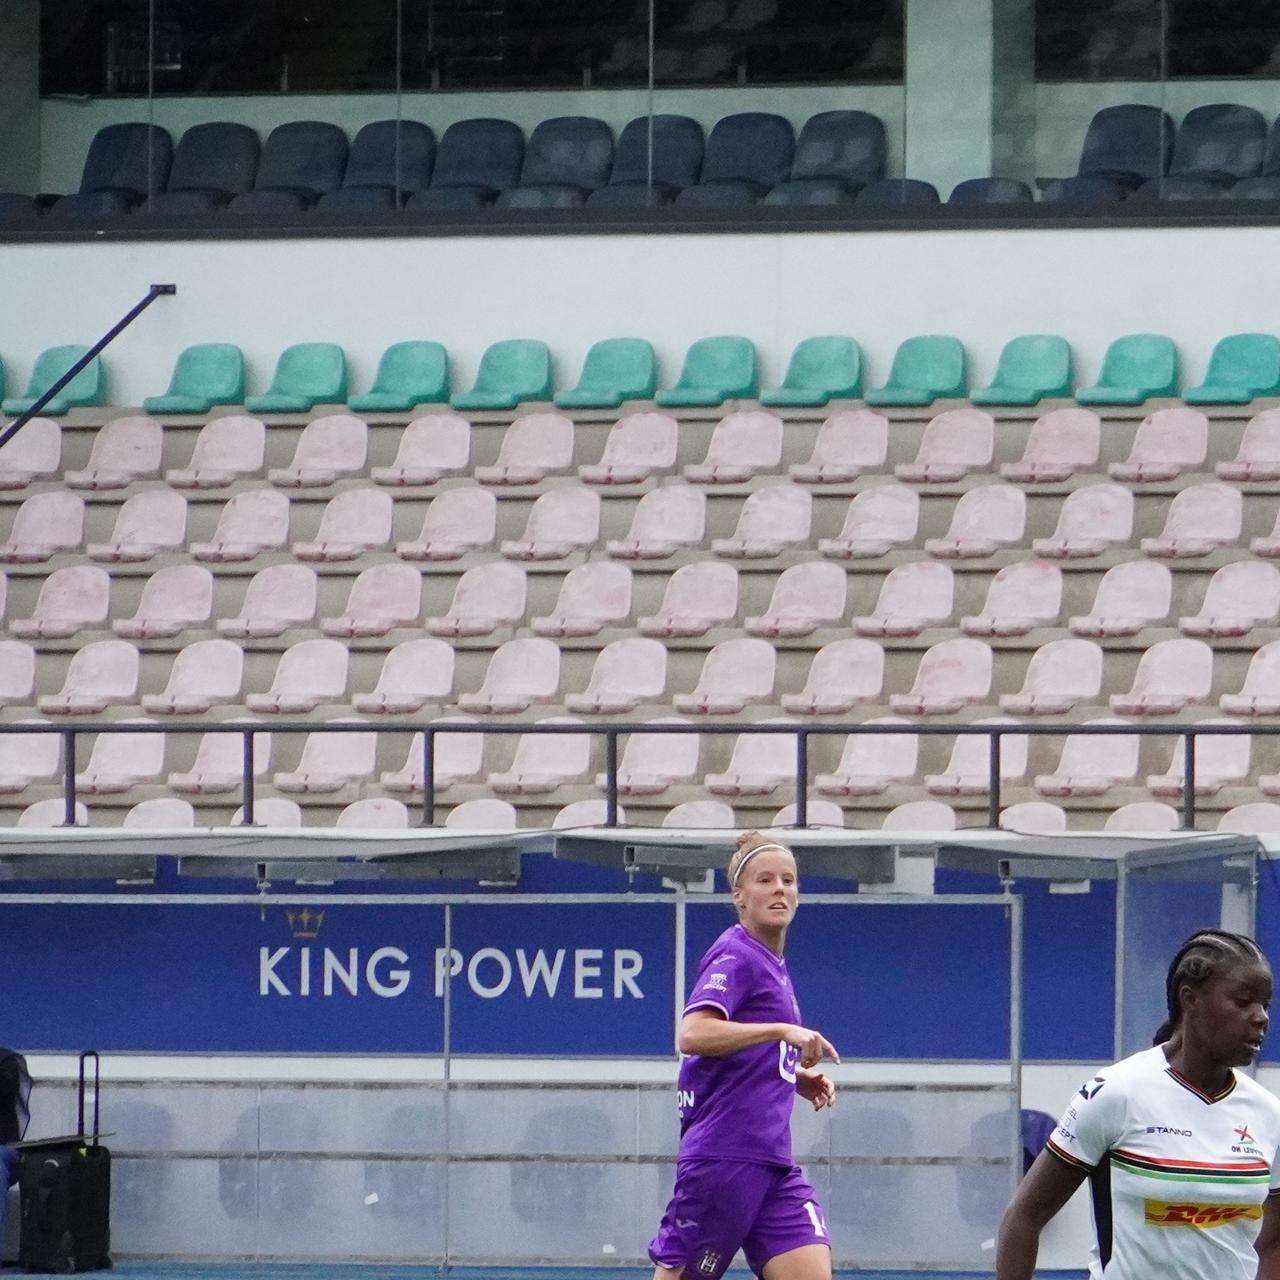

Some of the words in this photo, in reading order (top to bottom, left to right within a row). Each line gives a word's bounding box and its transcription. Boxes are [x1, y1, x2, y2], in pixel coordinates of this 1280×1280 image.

[259, 946, 411, 999] KING
[434, 947, 645, 999] POWER
[1146, 1126, 1192, 1137] STANNO
[803, 1201, 827, 1236] 1
